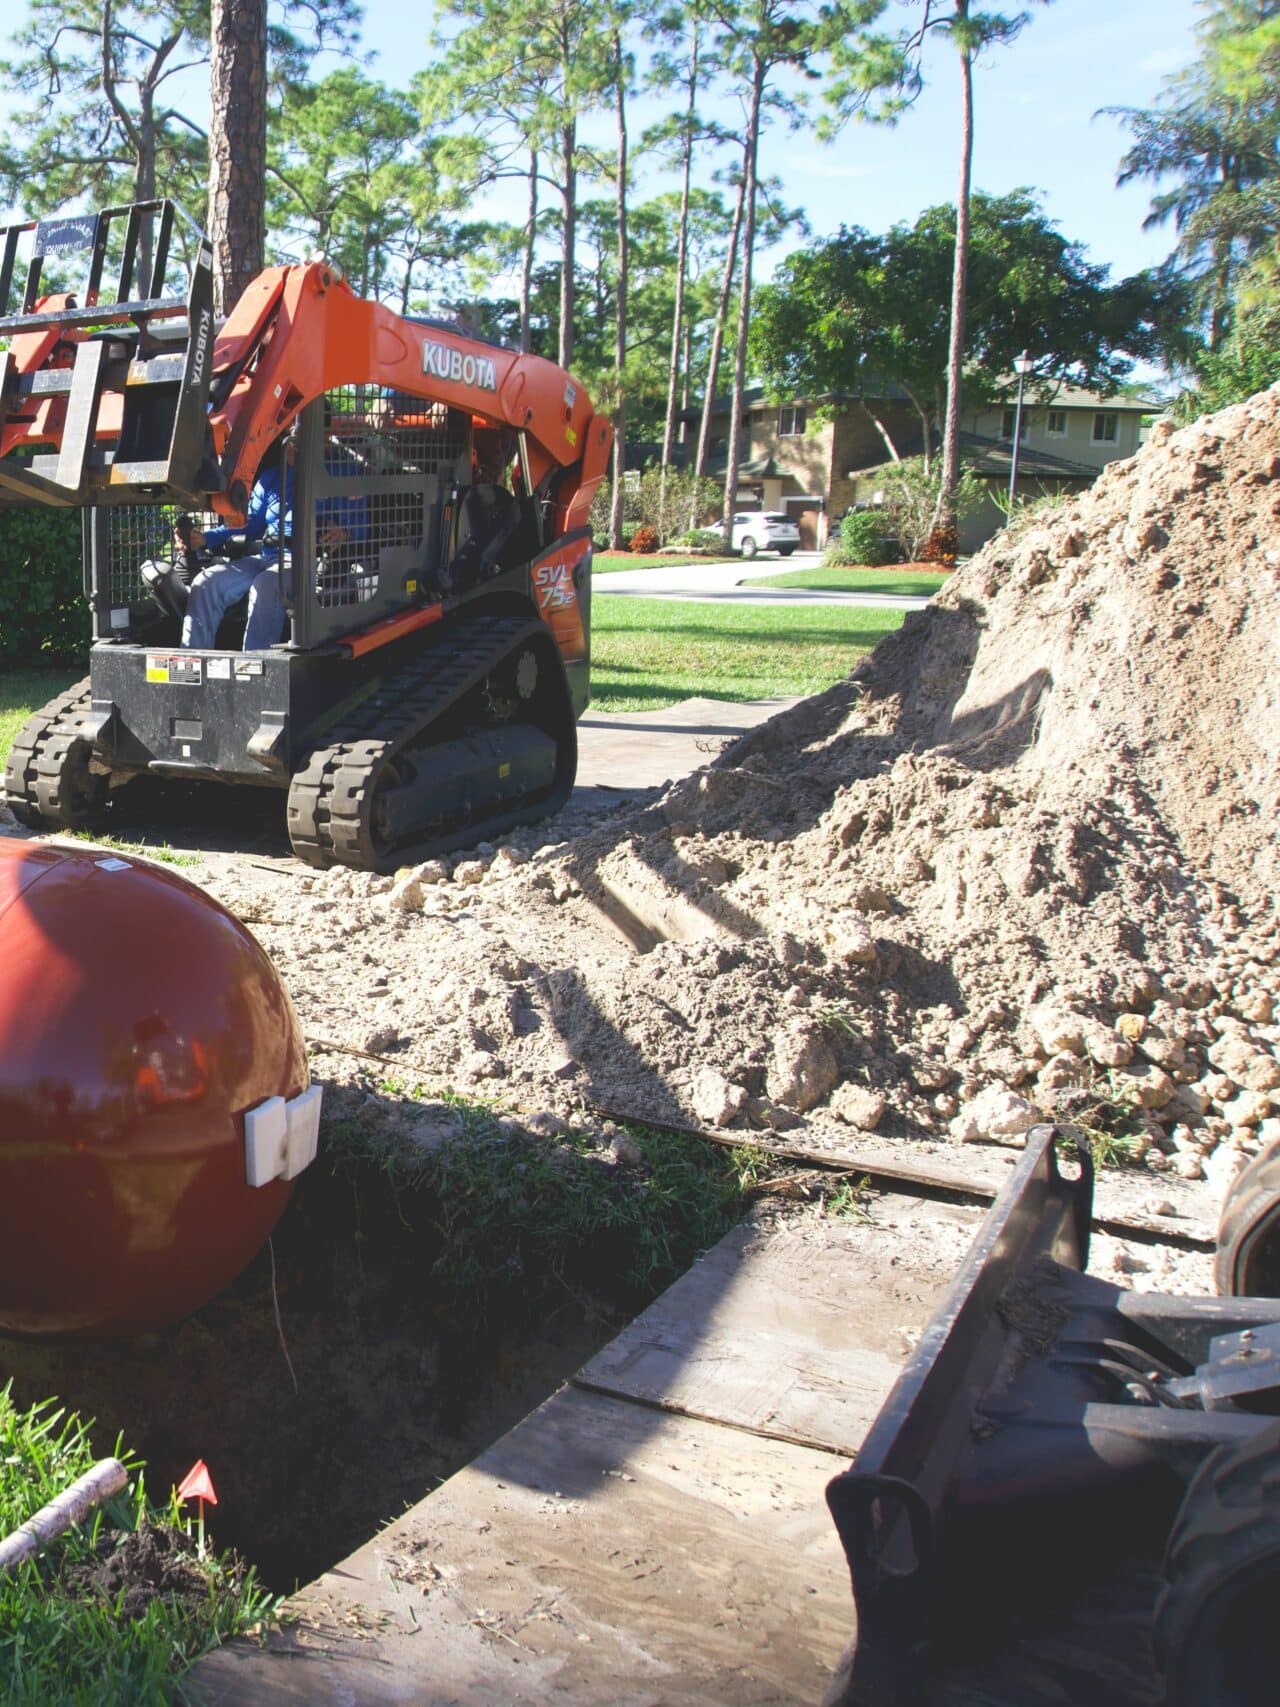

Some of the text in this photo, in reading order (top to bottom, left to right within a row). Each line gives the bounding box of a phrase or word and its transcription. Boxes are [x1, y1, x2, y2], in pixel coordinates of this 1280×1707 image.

[192, 308, 210, 384] KUBOTA
[422, 341, 497, 392] KUBOTA
[536, 564, 571, 585] SVL
